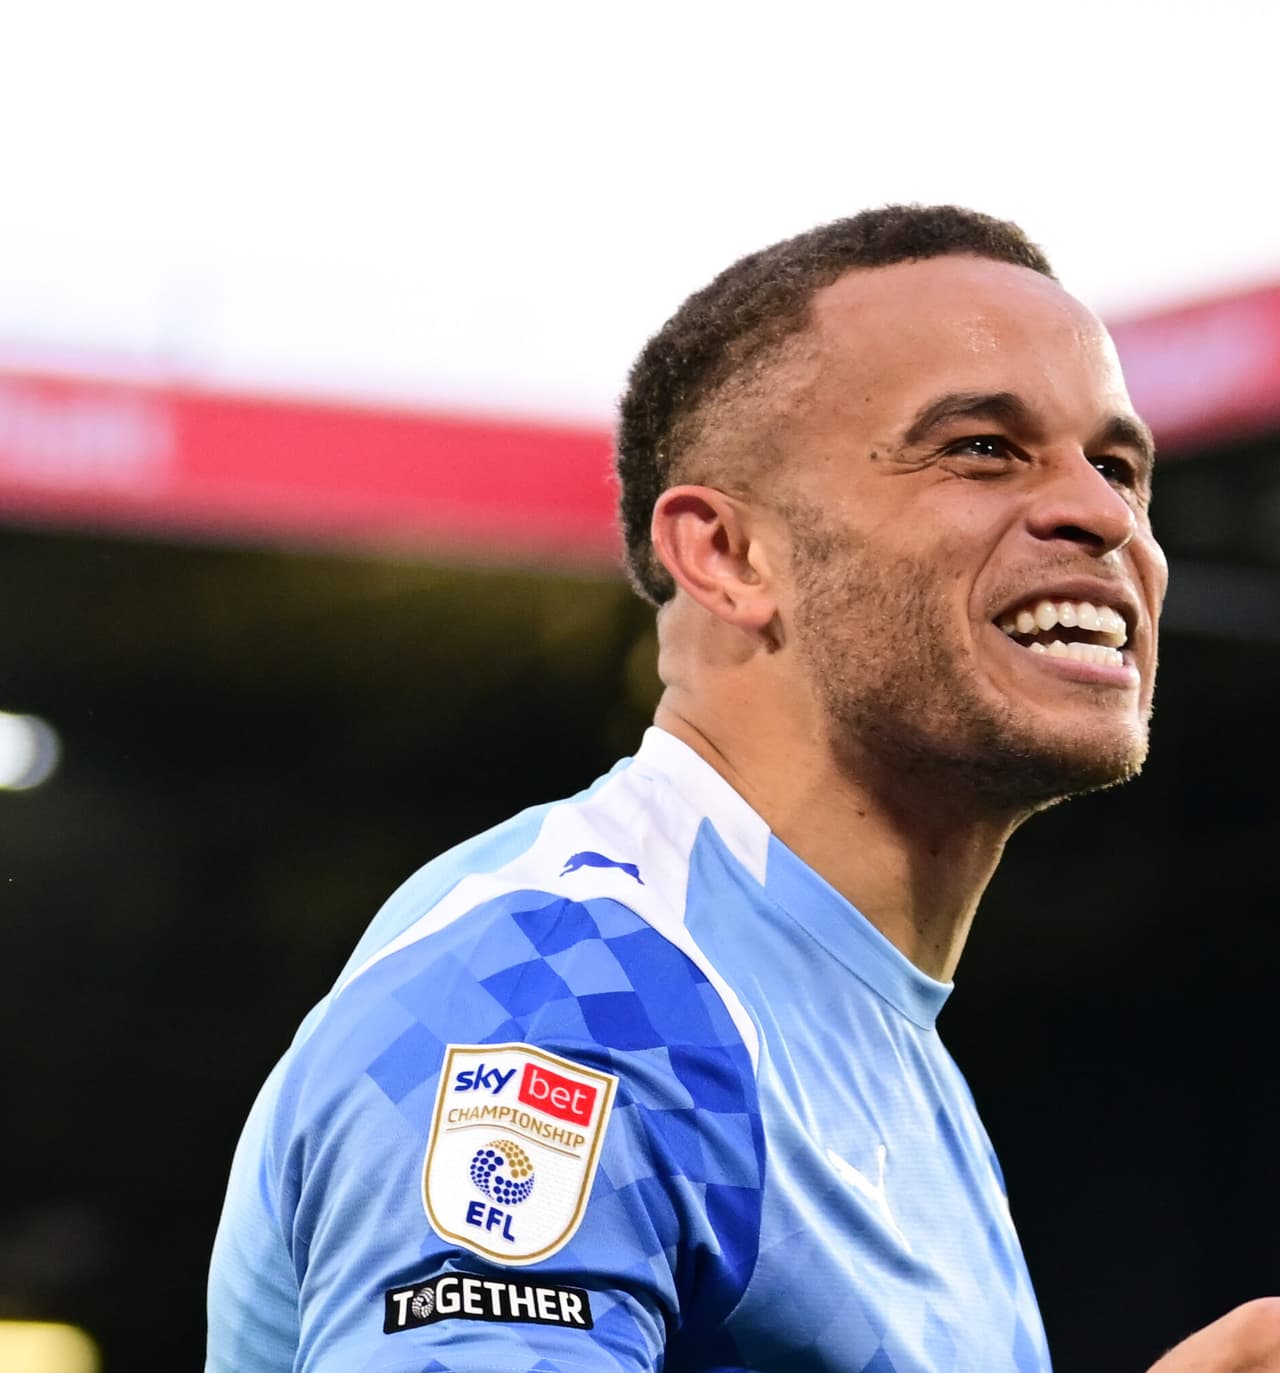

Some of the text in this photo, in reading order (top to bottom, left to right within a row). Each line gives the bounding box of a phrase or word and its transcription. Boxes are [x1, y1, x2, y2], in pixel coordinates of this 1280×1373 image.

[454, 1063, 589, 1116] sky bet
[447, 1104, 586, 1149] CHAMPIONSHIP
[465, 1200, 516, 1242] EFL
[392, 1277, 586, 1326] TOGETHER
